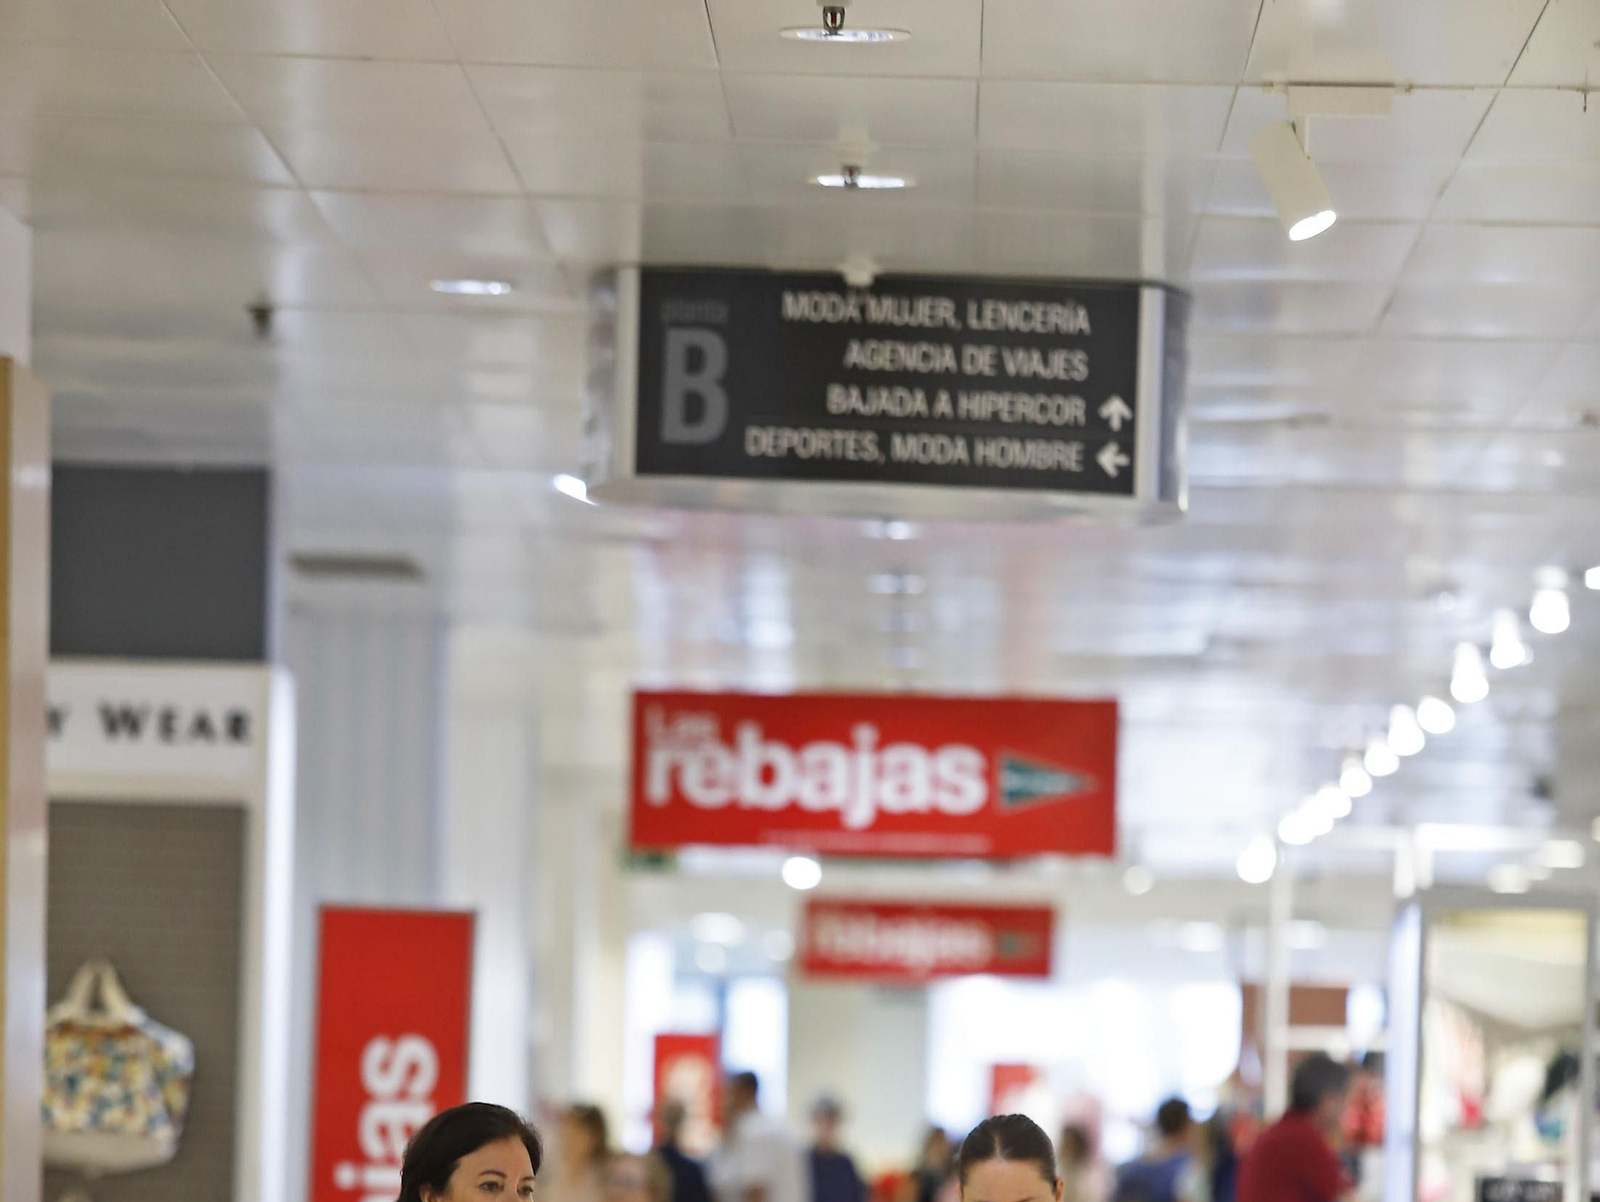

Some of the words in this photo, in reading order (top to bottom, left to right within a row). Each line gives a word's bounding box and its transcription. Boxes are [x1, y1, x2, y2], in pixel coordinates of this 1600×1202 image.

[781, 290, 861, 323] MODA
[865, 295, 962, 331] MUJER,
[966, 297, 1091, 336] LENCERÍA
[843, 338, 957, 374] AGENCIA
[961, 343, 998, 377] DE
[1001, 346, 1089, 381] VIAJES
[660, 325, 729, 444] B
[826, 382, 929, 418] BAJADA
[932, 387, 953, 419] A
[956, 389, 1086, 427] HIPERCOR
[744, 425, 886, 466] DEPORTES,
[890, 431, 970, 467] MODA
[973, 436, 1085, 472] HOMBRE
[644, 720, 991, 831] rebajas
